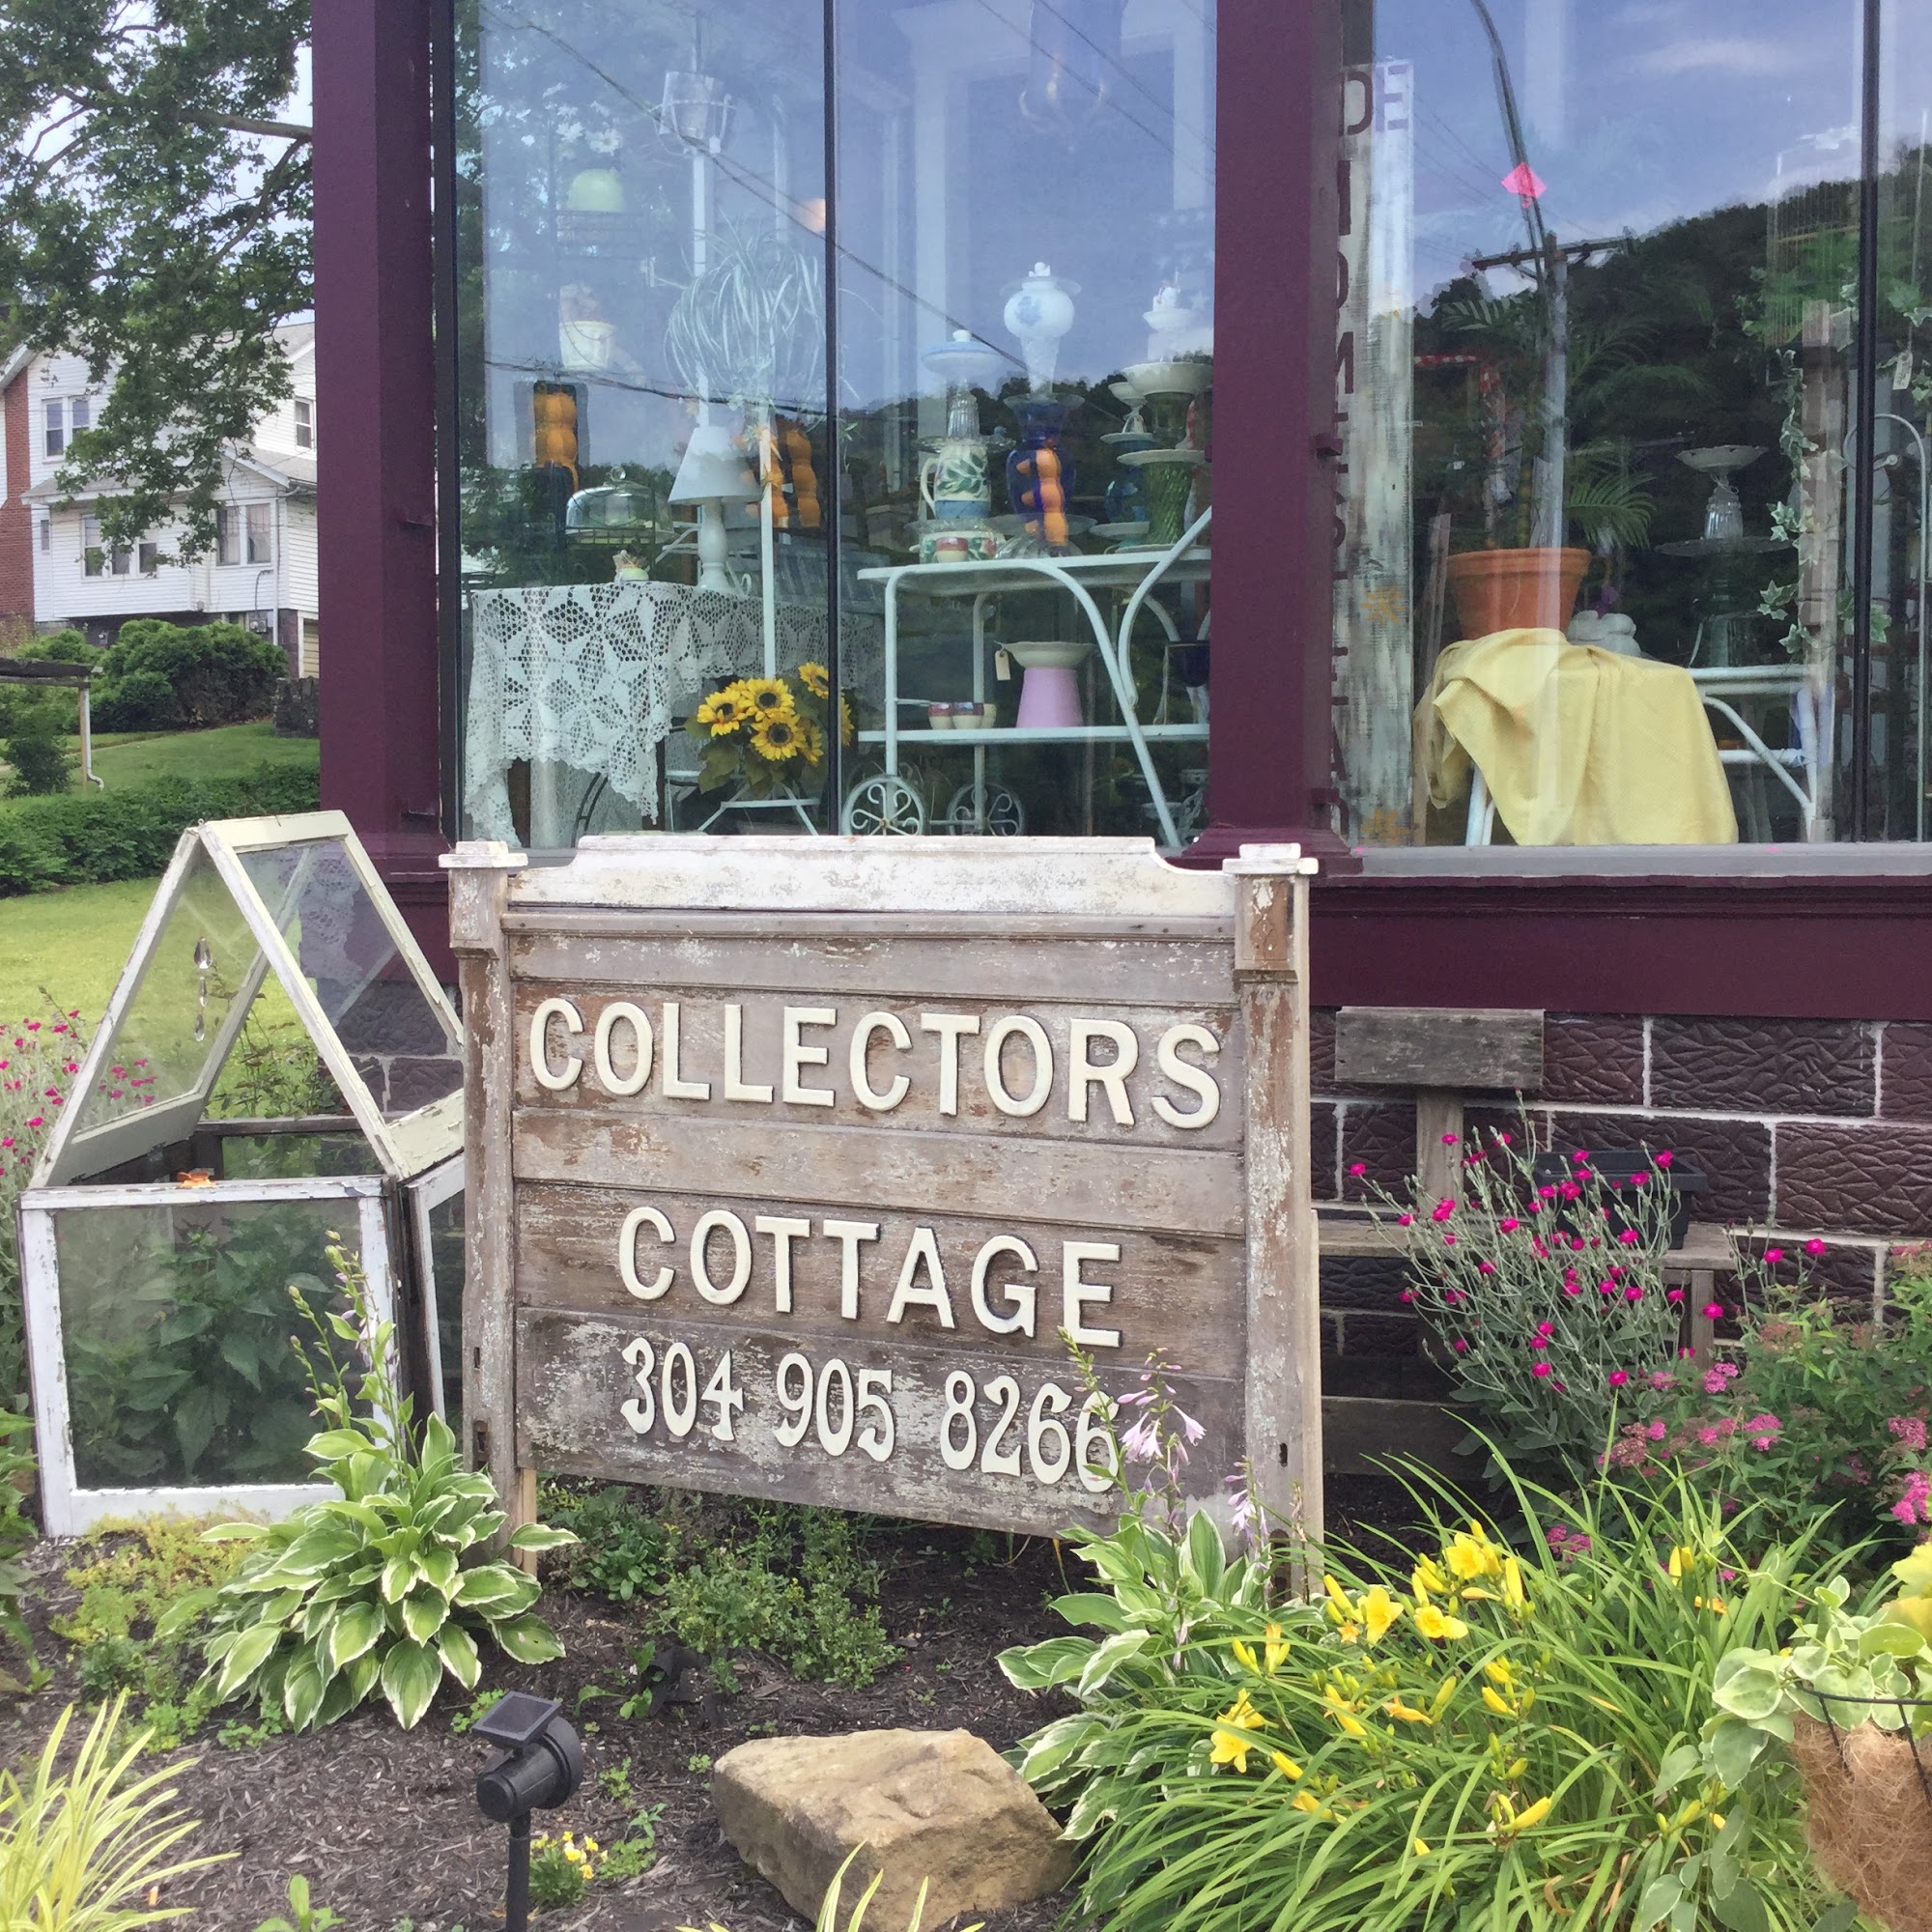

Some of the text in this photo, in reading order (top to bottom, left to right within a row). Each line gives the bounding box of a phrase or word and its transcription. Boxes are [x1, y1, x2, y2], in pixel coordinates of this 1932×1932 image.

[529, 997, 1221, 1129] COLLECTORS
[618, 1207, 1121, 1348] COTTAGE
[620, 1337, 1119, 1492] 304 905 8266
